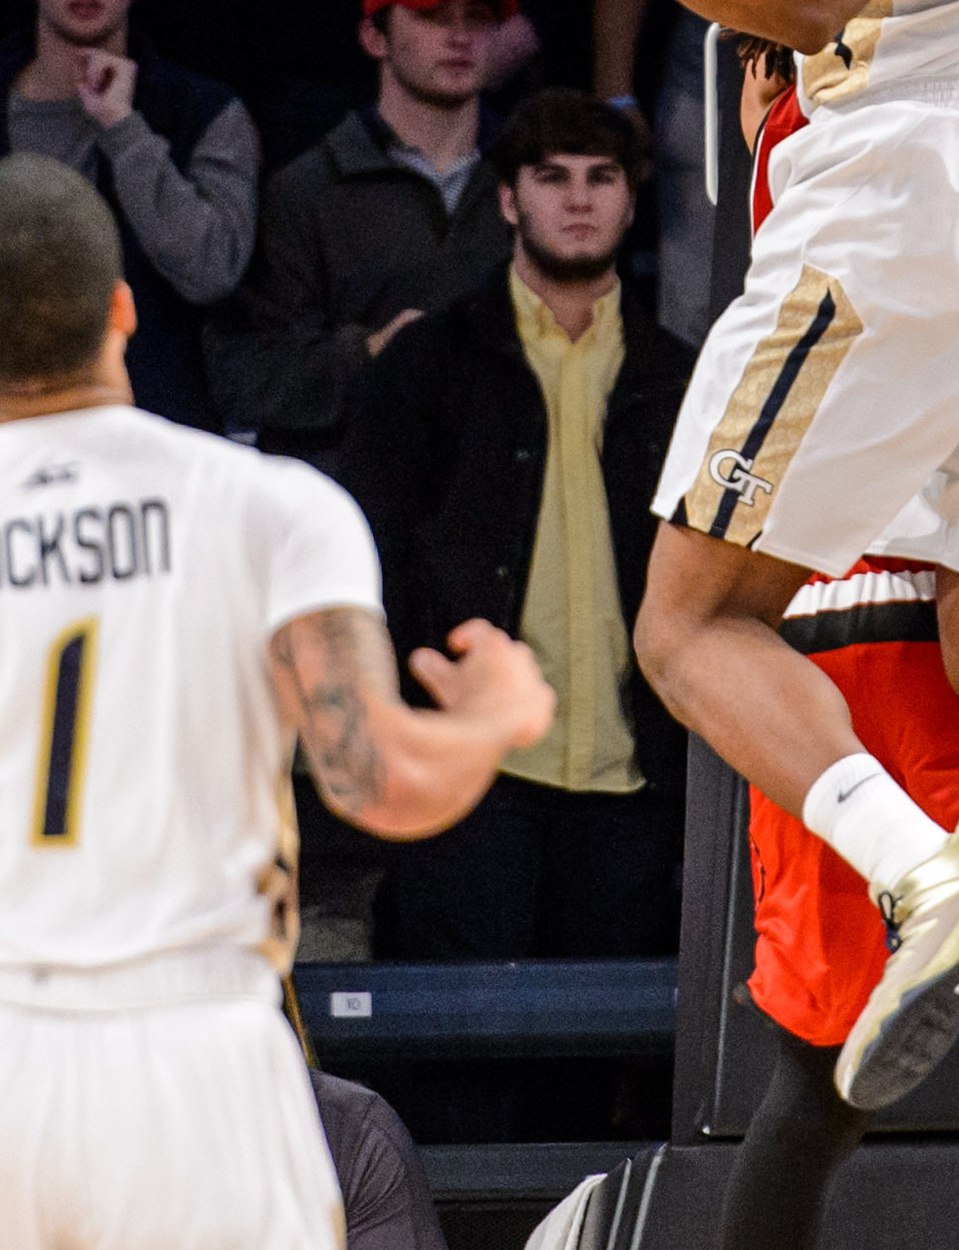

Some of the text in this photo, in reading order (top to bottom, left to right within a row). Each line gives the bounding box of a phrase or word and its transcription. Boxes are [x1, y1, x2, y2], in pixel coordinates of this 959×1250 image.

[709, 448, 774, 507] GT
[0, 496, 171, 587] CKSON
[32, 616, 98, 847] 1
